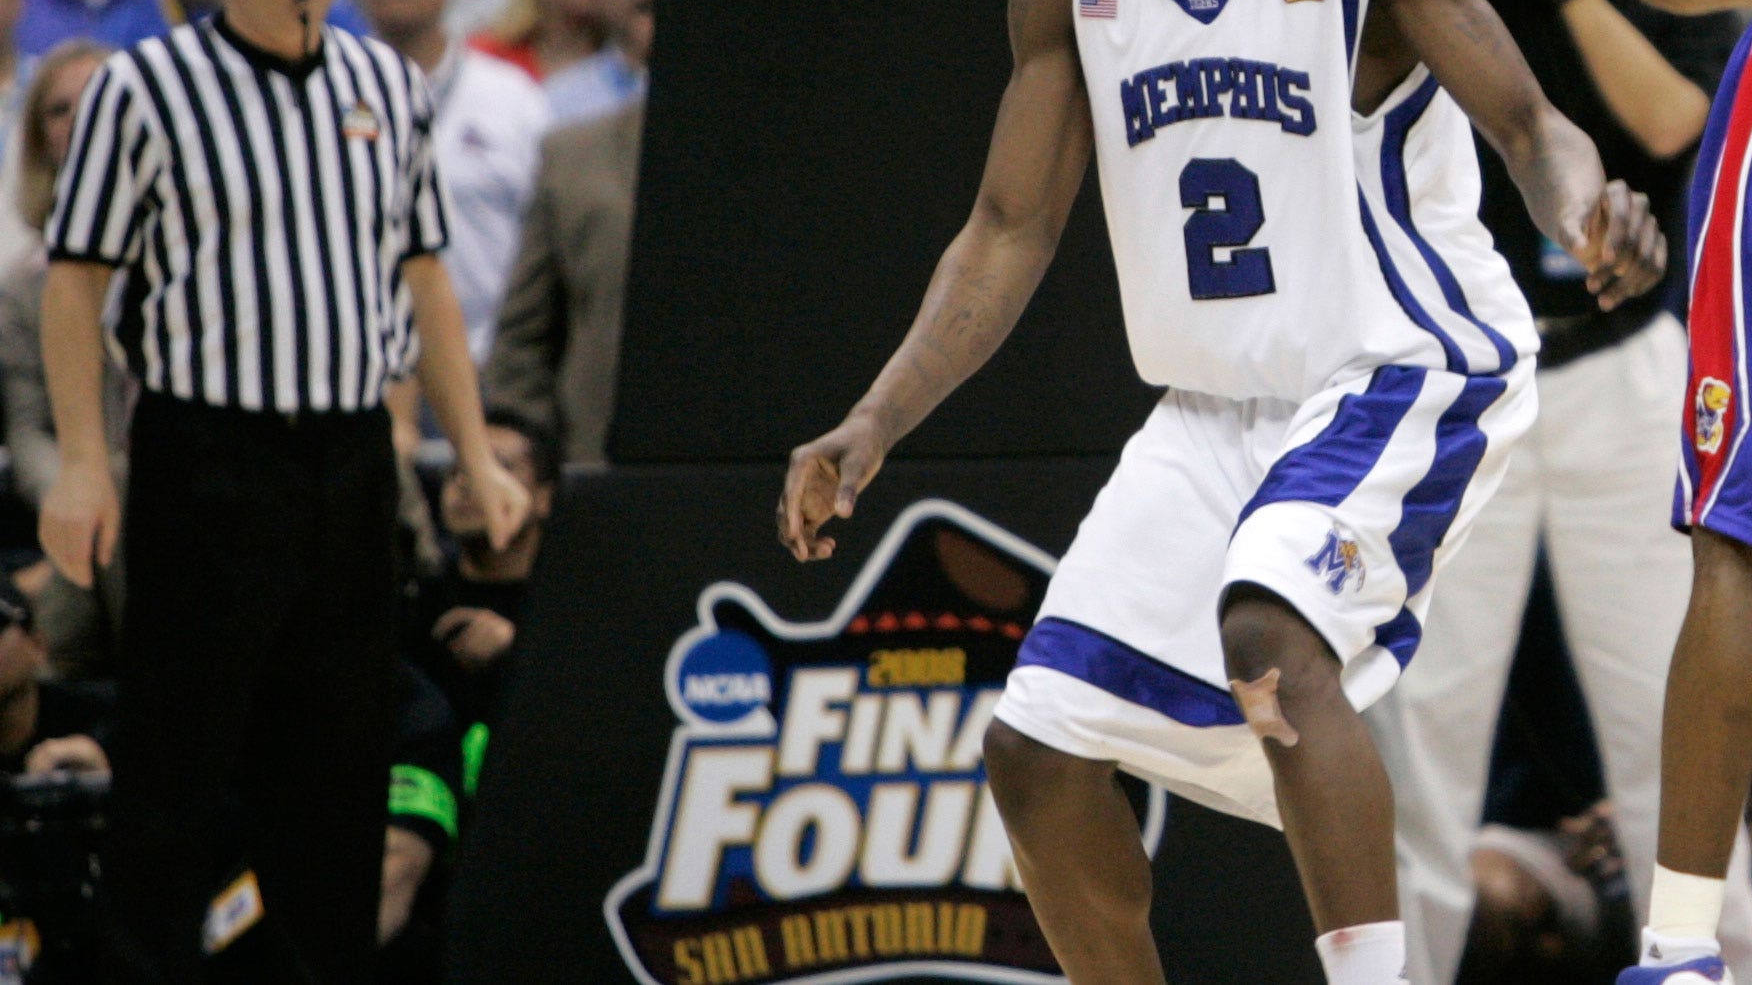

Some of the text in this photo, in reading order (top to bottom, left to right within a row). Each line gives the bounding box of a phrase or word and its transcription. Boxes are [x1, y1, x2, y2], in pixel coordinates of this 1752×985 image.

[1120, 56, 1317, 149] MEMPHIS
[1178, 157, 1277, 300] 2
[684, 672, 771, 705] NCAA
[779, 667, 1008, 777] FINA
[673, 902, 987, 985] SAN ANTONIO
